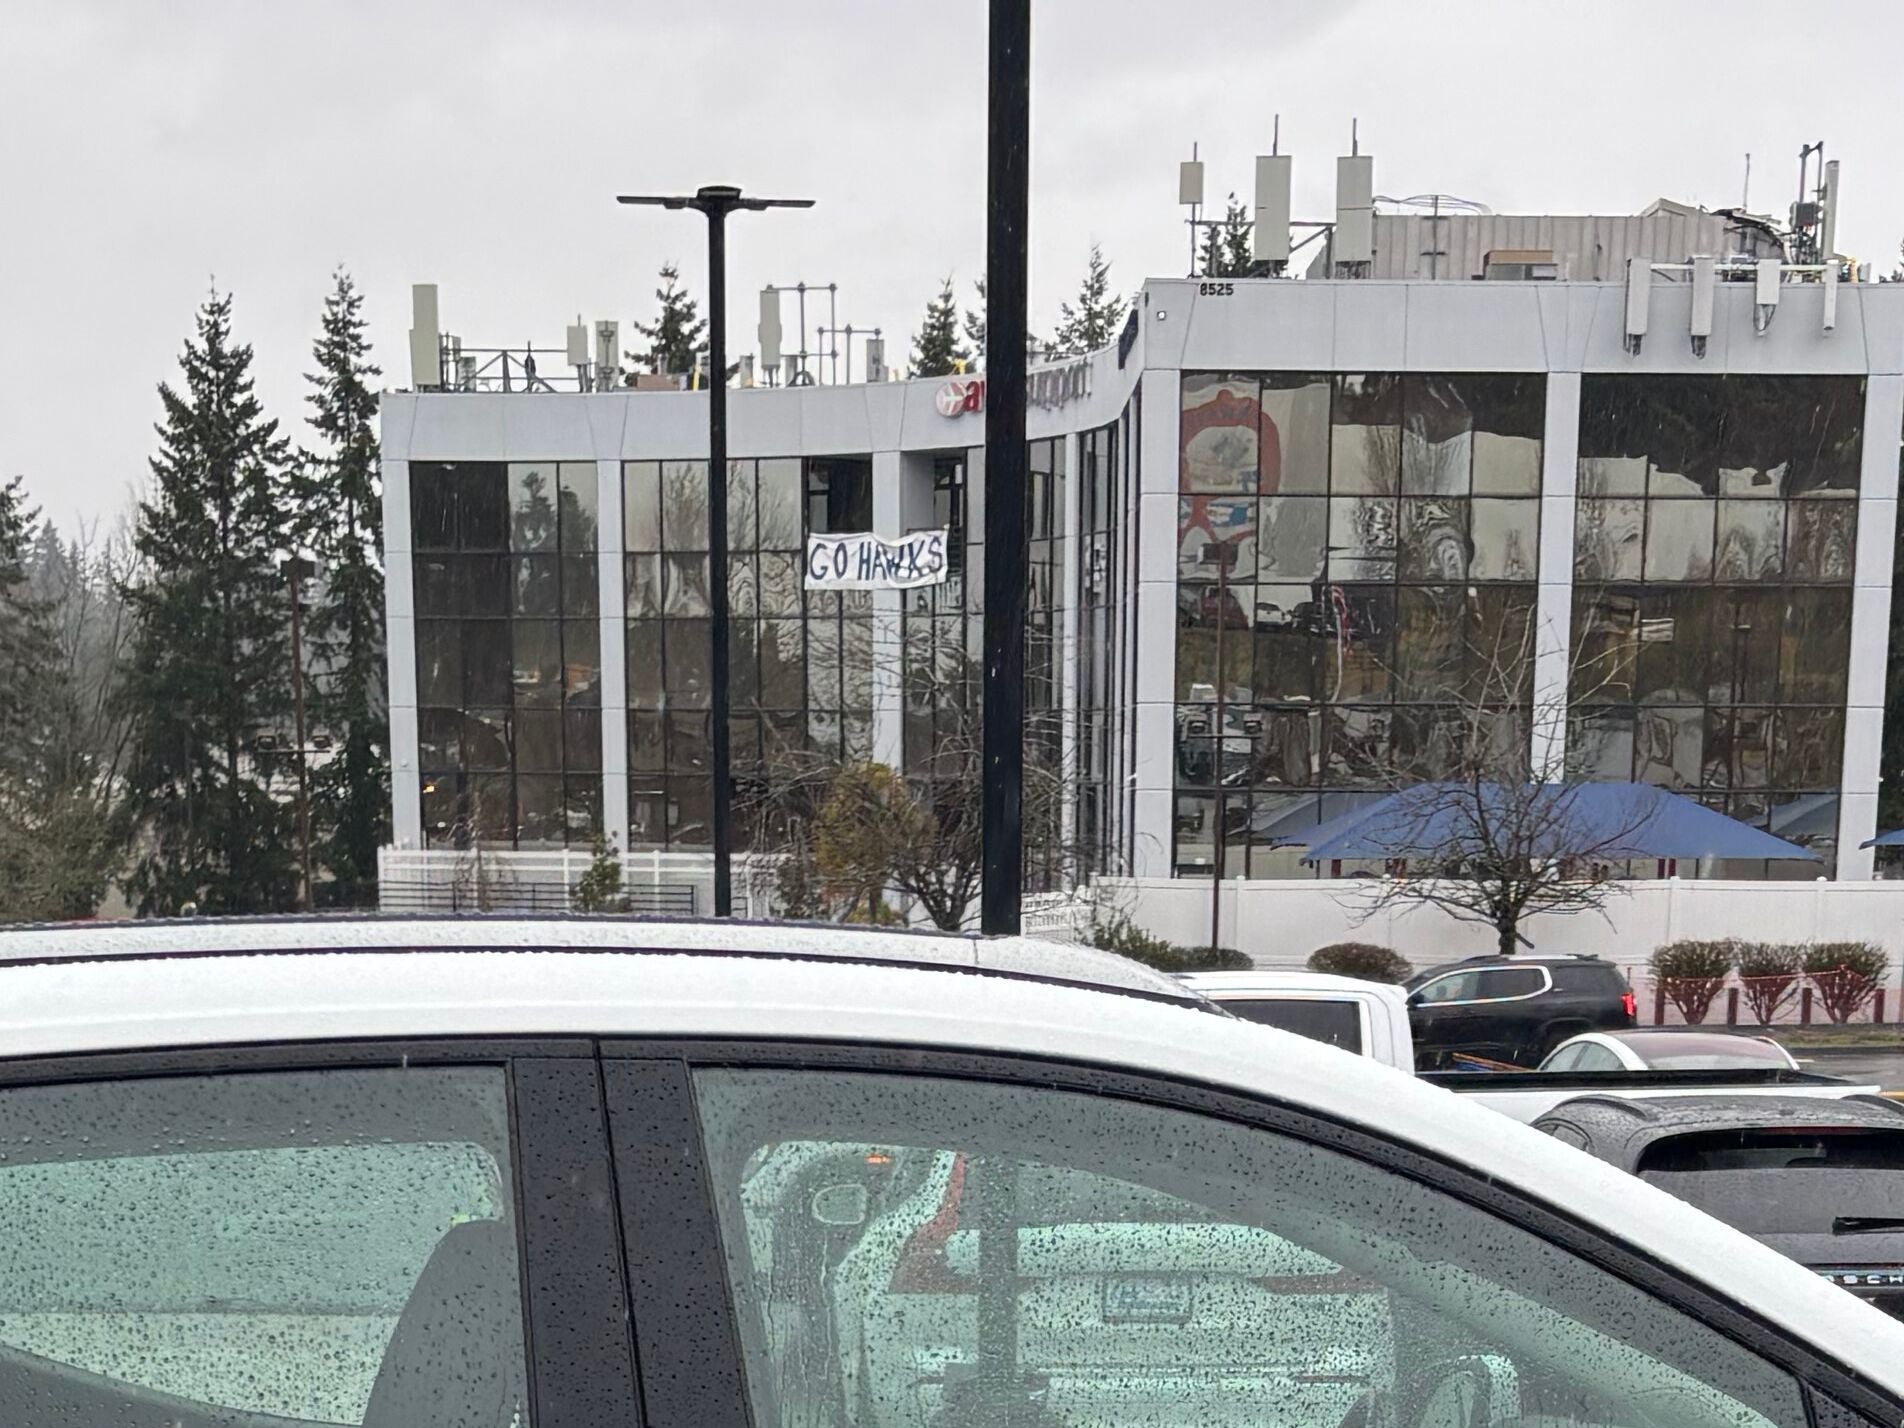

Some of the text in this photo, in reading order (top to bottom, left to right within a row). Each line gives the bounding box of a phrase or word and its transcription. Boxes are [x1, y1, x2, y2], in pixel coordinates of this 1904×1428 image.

[1199, 282, 1234, 296] 8525
[810, 536, 943, 580] GO HAWKS
